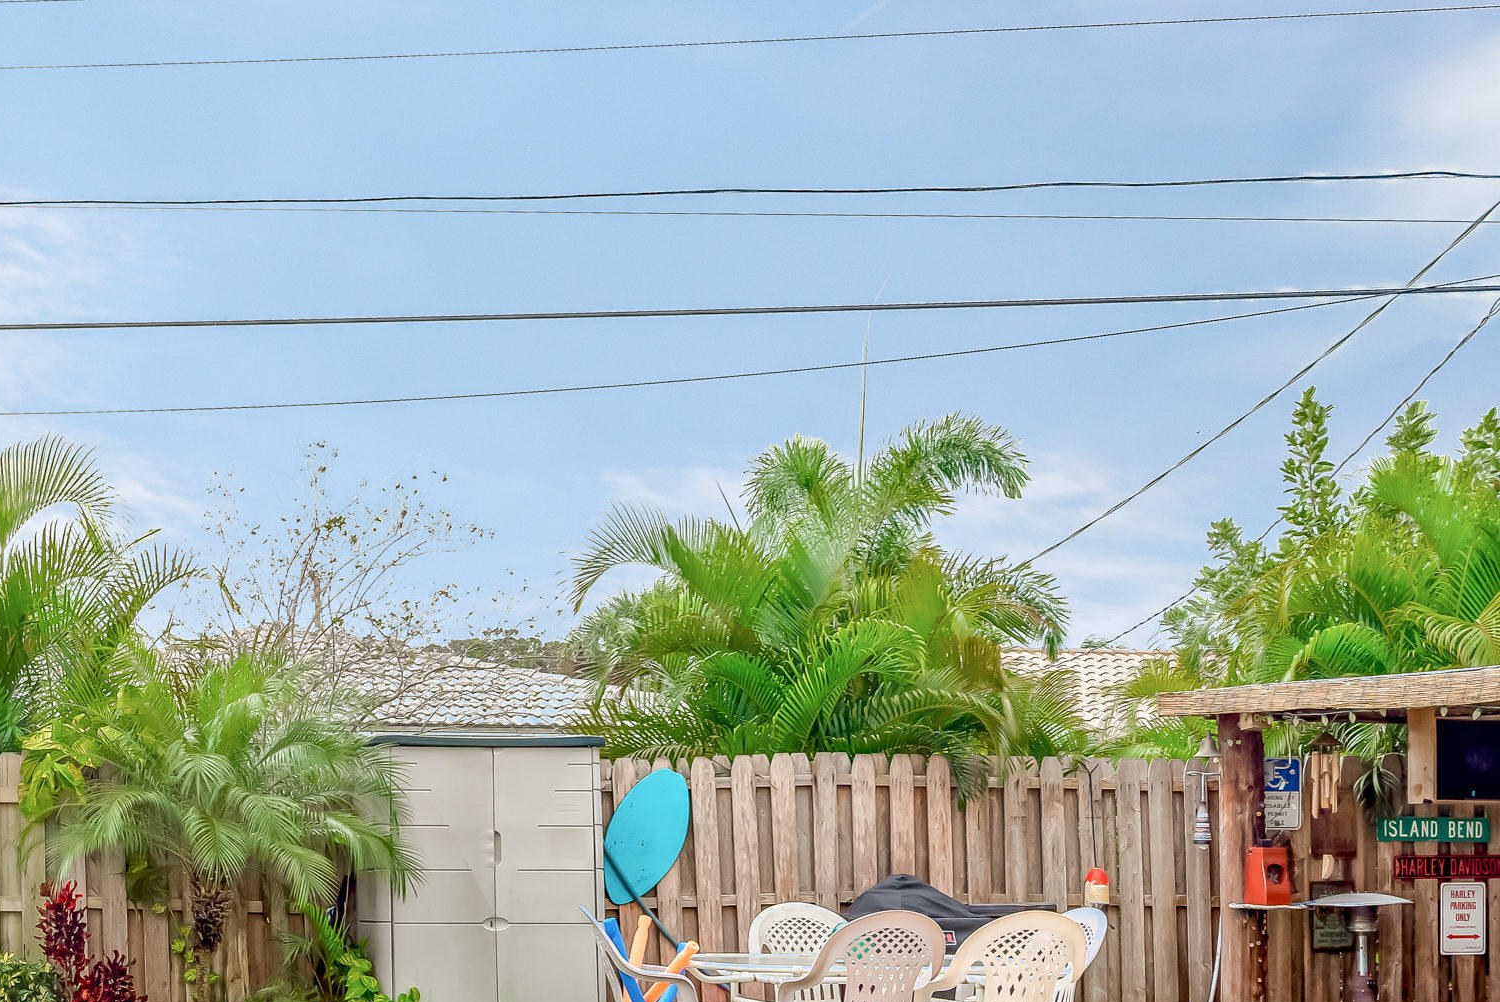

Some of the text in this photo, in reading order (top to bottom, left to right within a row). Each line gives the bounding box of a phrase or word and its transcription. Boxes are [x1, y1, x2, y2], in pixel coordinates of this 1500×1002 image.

[1383, 819, 1483, 838] ISLAND BEND
[1401, 858, 1445, 876] HARLEY
[1450, 889, 1476, 899] HARLEY
[1449, 901, 1477, 910] PARKING
[1455, 913, 1471, 922] ONLY
